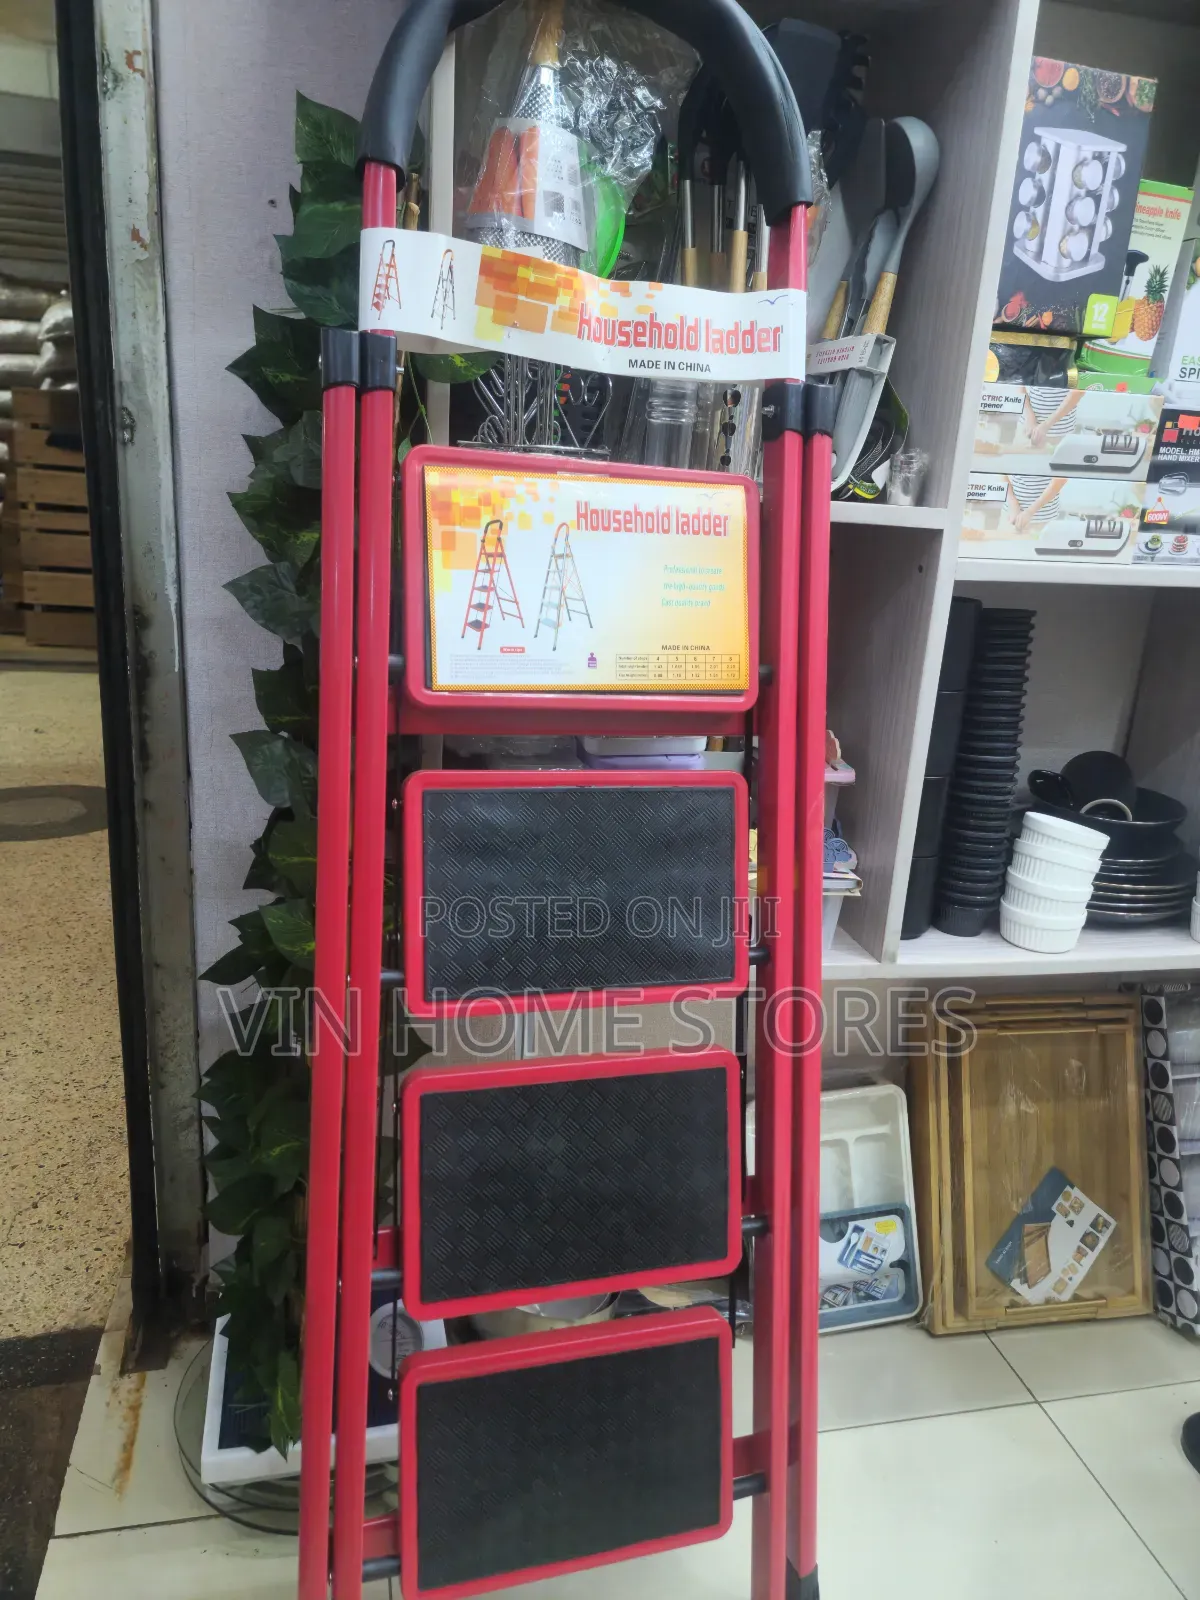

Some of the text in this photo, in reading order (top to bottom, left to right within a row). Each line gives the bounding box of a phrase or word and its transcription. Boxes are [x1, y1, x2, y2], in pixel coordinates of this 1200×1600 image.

[1092, 302, 1109, 322] 12
[577, 302, 783, 354] Household ladder
[628, 359, 711, 373] MADE IN CHINA
[1004, 396, 1022, 404] Knife
[1159, 446, 1188, 455] MODEL:
[1158, 453, 1200, 463] HAND MIXER
[576, 500, 730, 537] Household ladder
[1148, 512, 1168, 522] 600W
